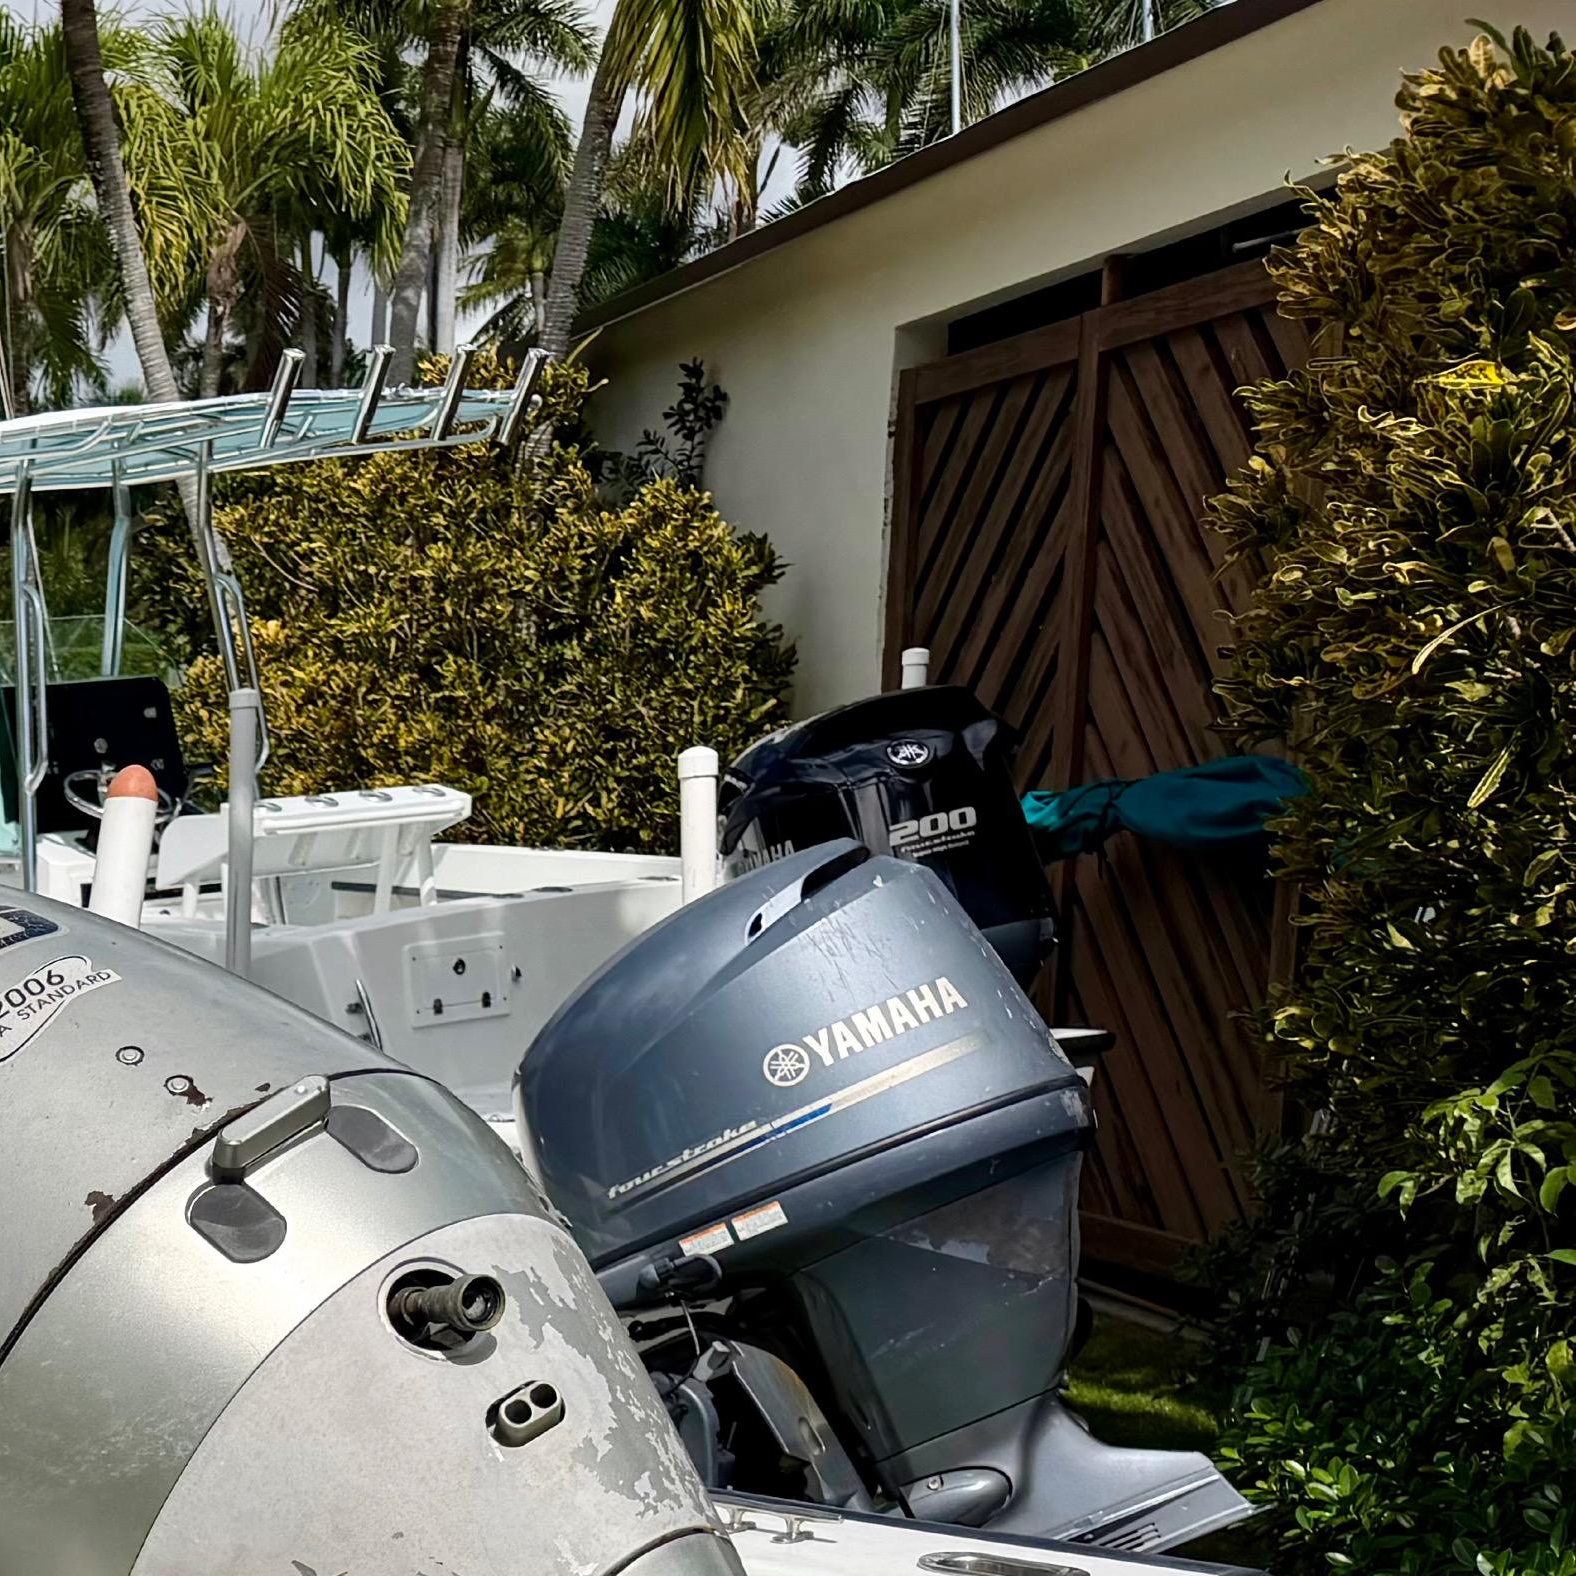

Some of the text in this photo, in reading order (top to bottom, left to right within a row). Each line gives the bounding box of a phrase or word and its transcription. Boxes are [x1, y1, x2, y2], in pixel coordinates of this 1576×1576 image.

[889, 807, 976, 846] 200
[17, 971, 111, 1021] STANDARD
[804, 977, 969, 1066] YAMAHA
[608, 1121, 757, 1199] fourstroke
